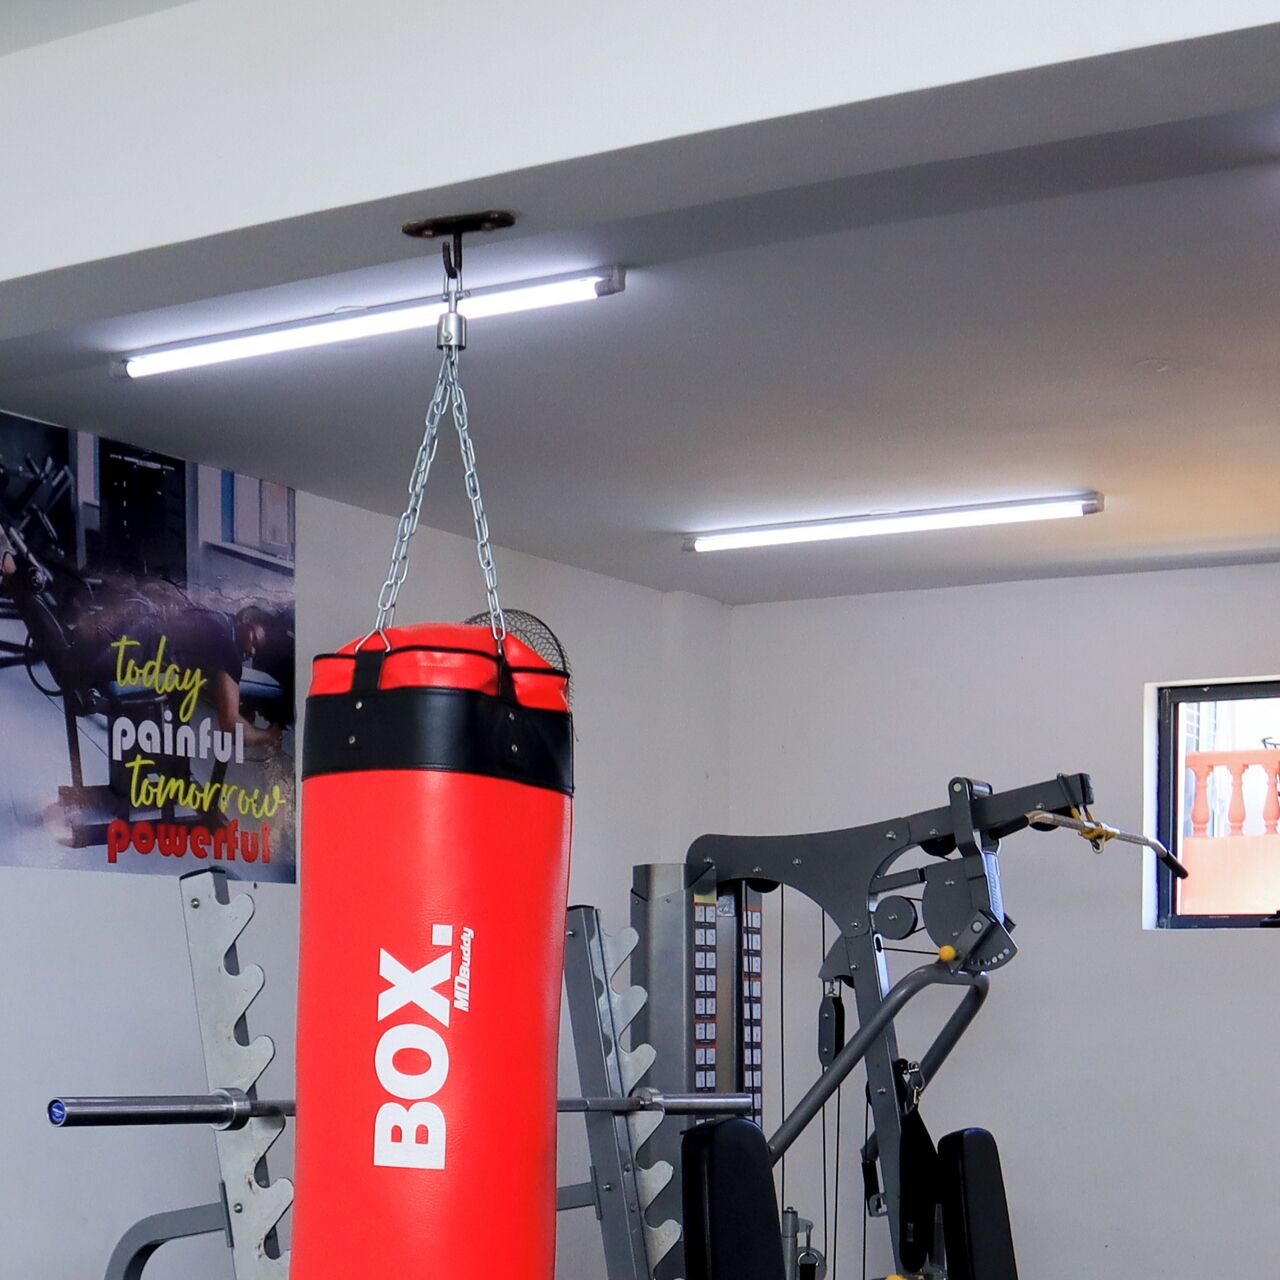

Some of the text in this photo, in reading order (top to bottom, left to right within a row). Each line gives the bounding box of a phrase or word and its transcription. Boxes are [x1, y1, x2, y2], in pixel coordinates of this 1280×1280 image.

[111, 635, 207, 723] today
[112, 710, 245, 764] painful
[125, 754, 286, 818] tomorrow
[107, 818, 271, 864] powerful
